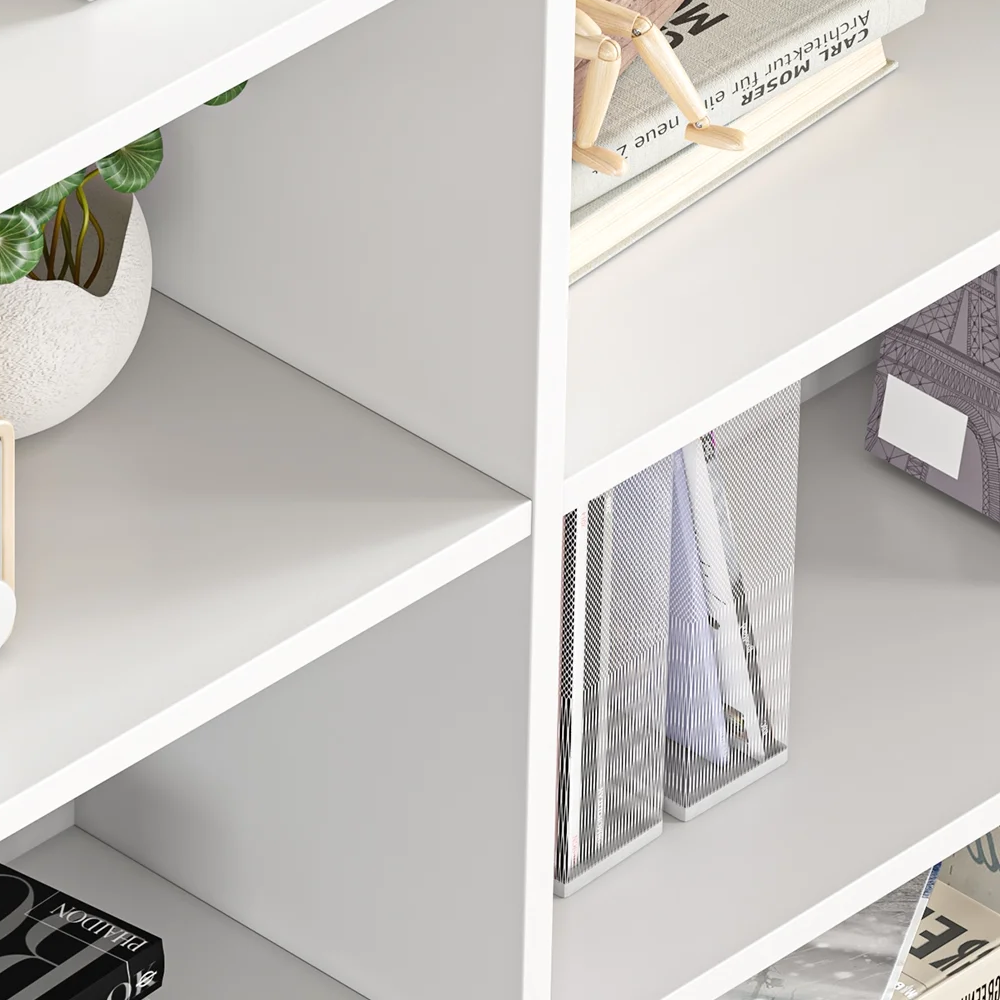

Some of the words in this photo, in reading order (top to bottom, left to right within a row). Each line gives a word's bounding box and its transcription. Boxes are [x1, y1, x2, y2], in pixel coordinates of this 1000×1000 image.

[764, 9, 871, 78] Architektur
[818, 27, 870, 65] CARL
[732, 68, 759, 96] für
[741, 58, 811, 107] MOSER
[635, 117, 680, 150] neue
[50, 902, 149, 953] PHAIDON
